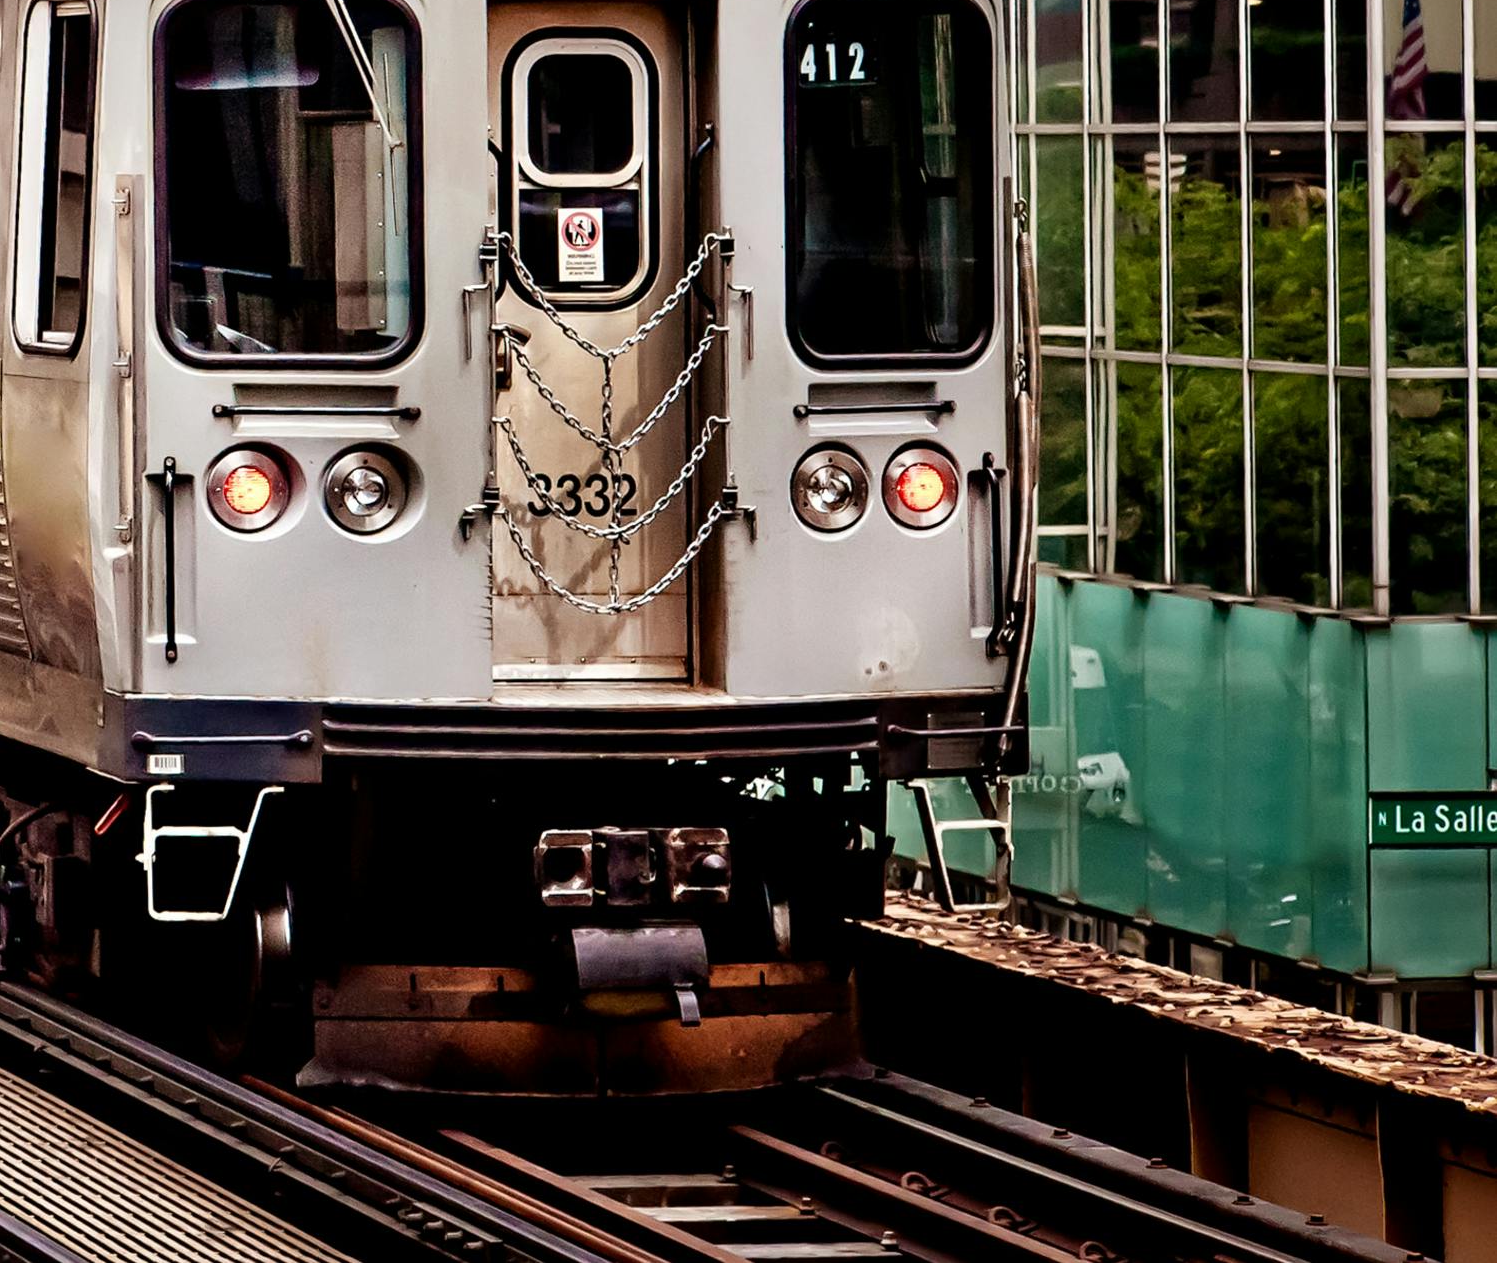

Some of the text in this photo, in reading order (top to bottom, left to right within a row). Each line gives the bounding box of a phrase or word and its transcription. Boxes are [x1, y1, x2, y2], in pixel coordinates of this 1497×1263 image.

[800, 42, 866, 82] 412
[527, 473, 637, 517] 3332
[1378, 804, 1497, 833] N La Salle
